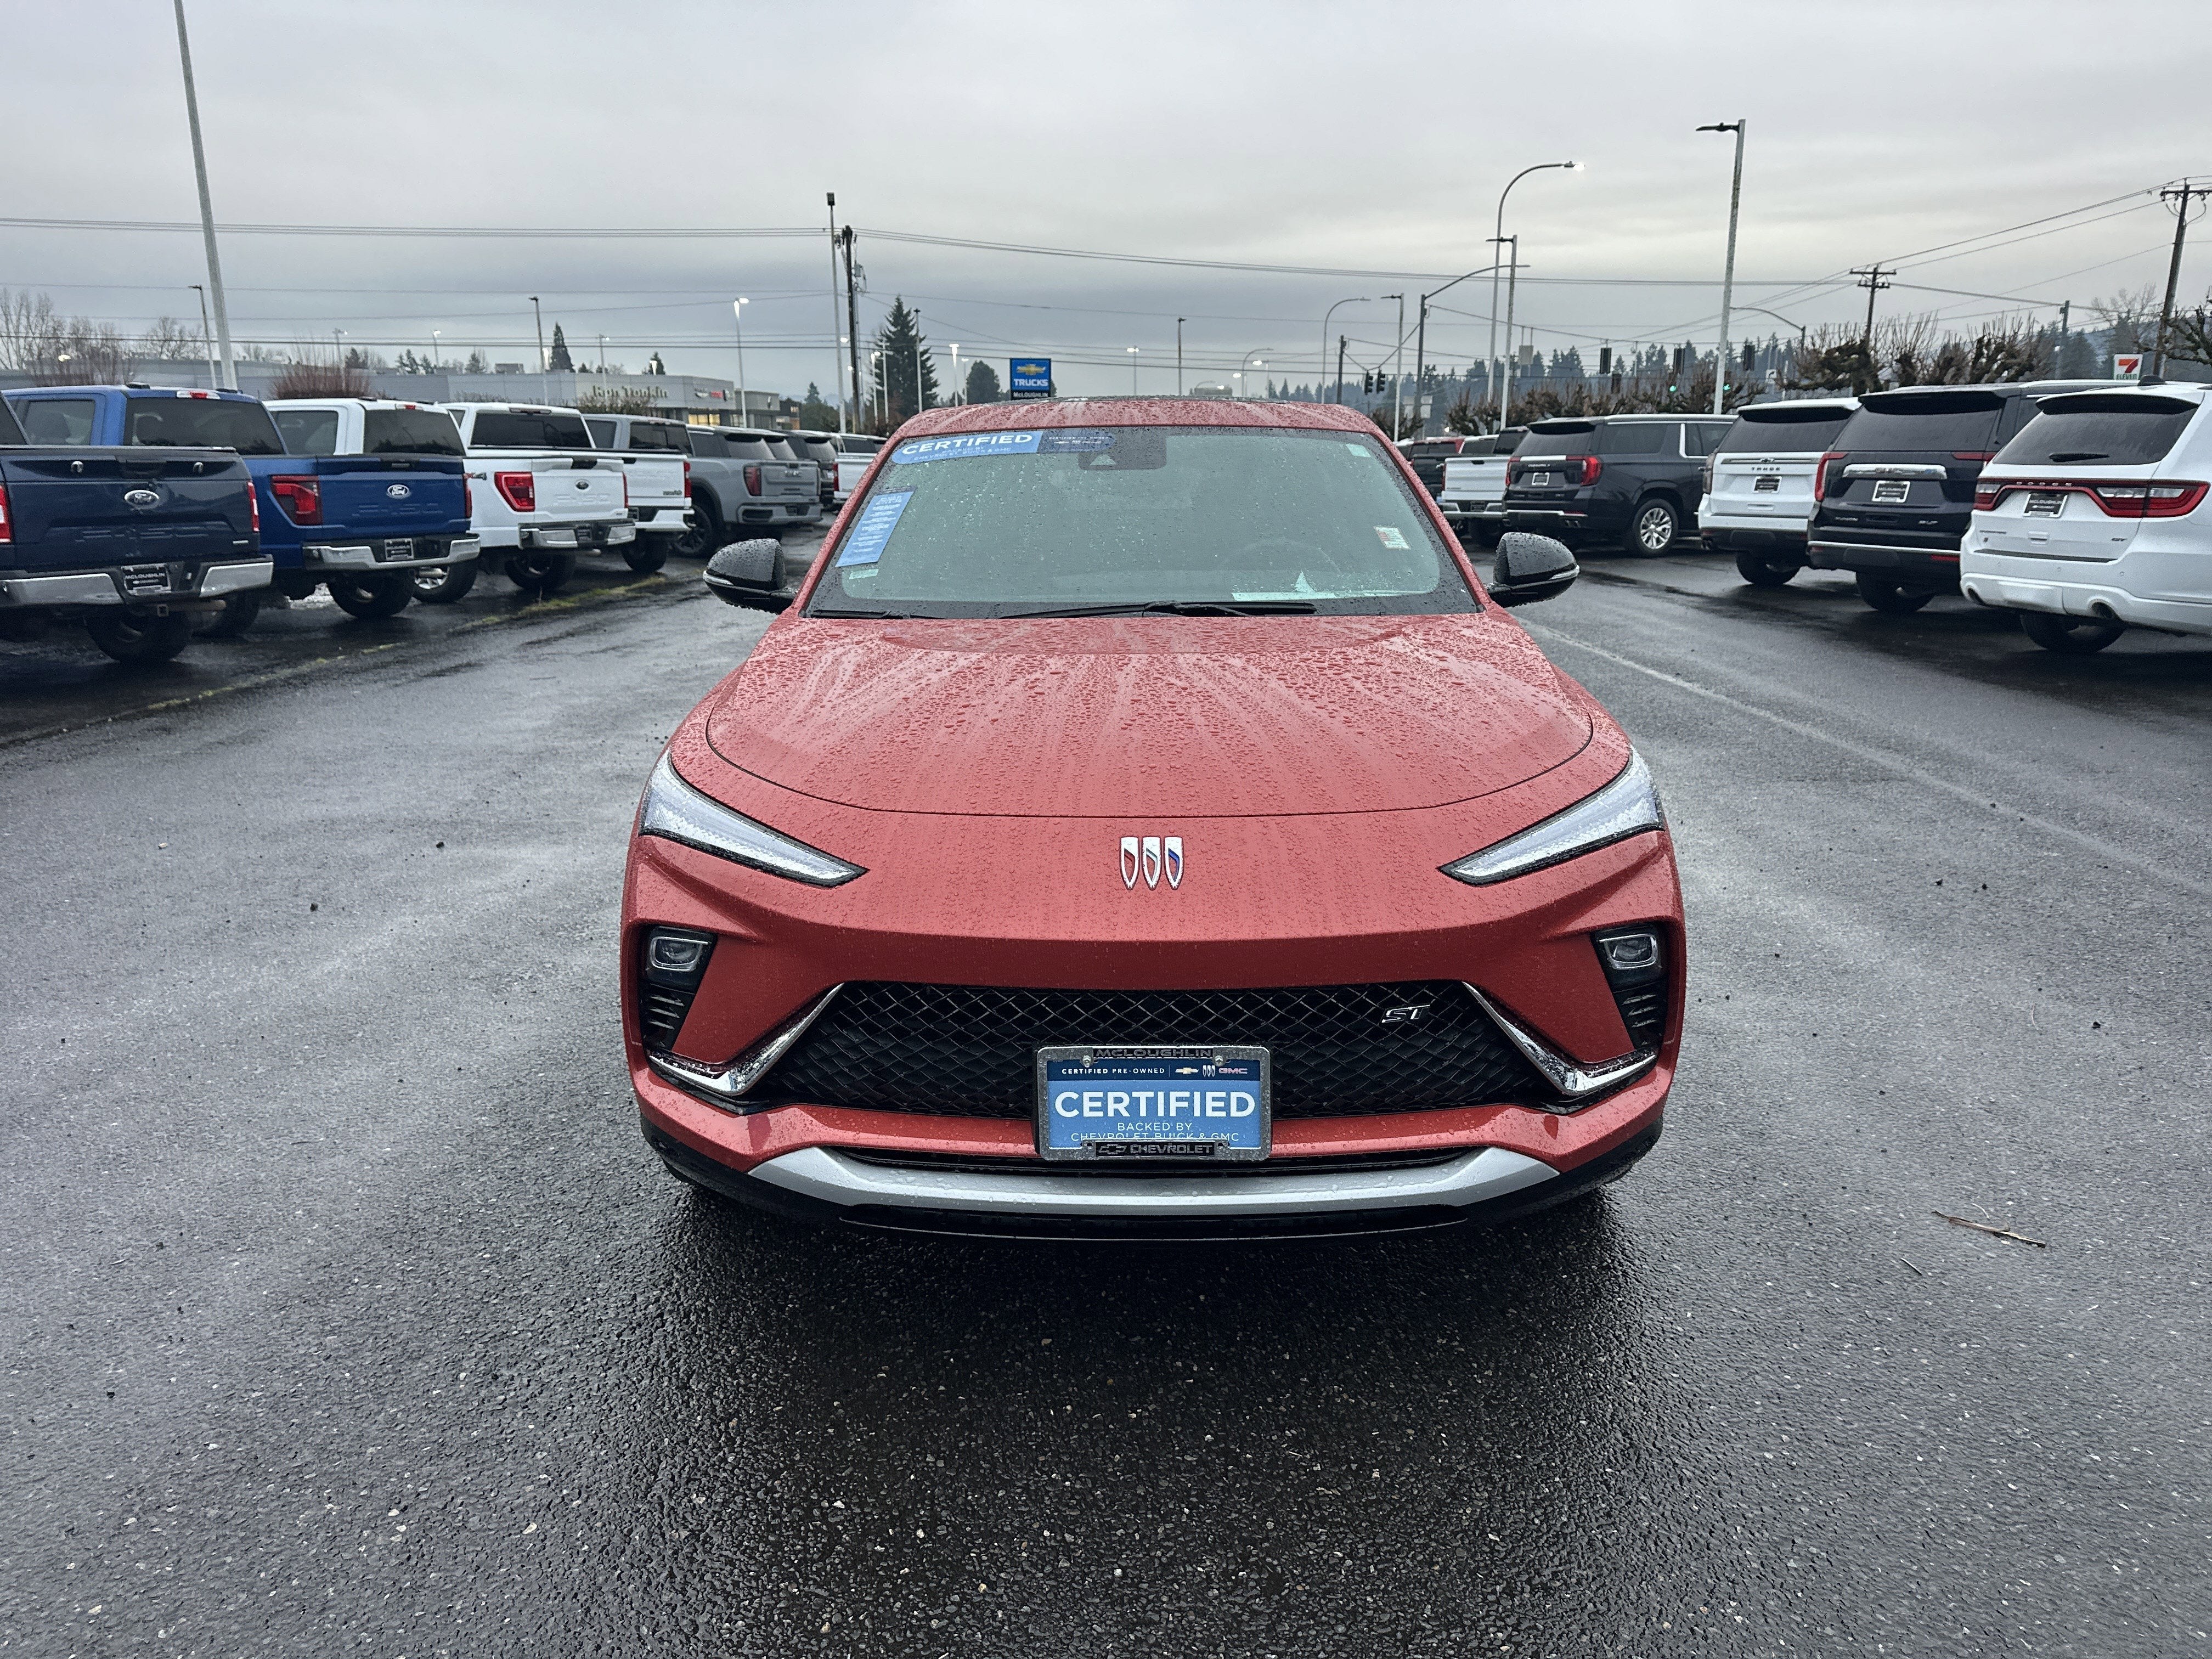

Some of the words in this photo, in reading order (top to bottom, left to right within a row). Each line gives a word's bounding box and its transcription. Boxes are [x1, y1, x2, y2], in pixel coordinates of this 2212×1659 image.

[2119, 358, 2138, 373] 7
[902, 434, 1032, 455] CERTIFIED
[1381, 1005, 1431, 1023] ST
[1097, 1049, 1211, 1057] MCLOUGHLIN
[1055, 1091, 1255, 1118] CERTIFIED
[1118, 1122, 1170, 1131] BACKED
[1176, 1122, 1193, 1131] BY
[1071, 1133, 1149, 1141] CHEVROLET
[1211, 1133, 1239, 1141] GMC
[1130, 1144, 1212, 1153] CHEVROLET
